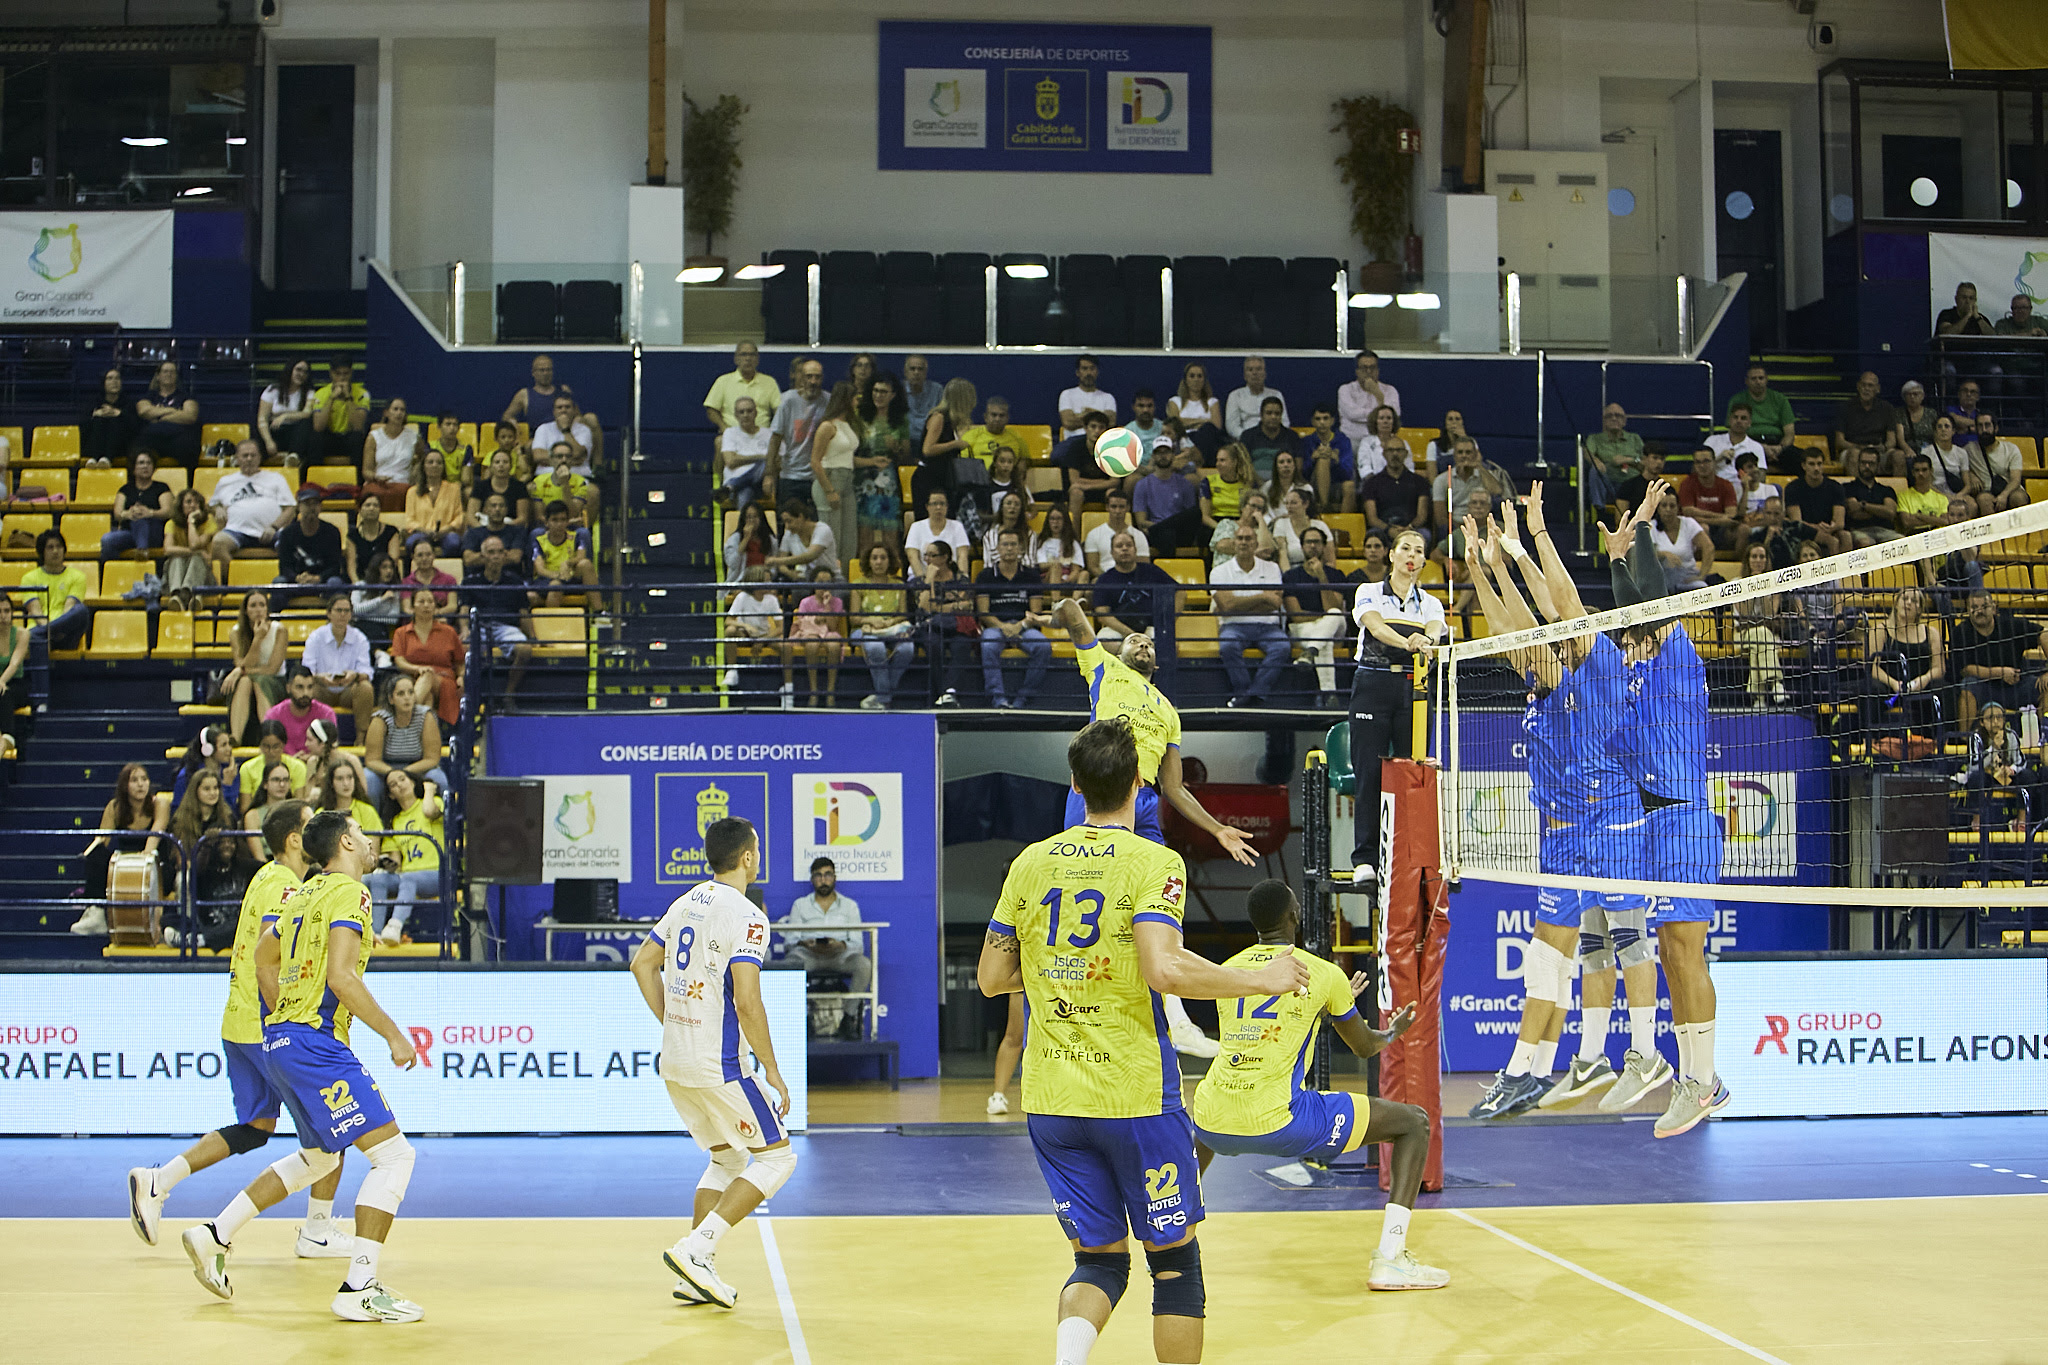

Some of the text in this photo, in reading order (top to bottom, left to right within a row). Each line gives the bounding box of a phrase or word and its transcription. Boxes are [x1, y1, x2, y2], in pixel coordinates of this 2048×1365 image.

[964, 46, 1130, 61] CONSEJERÍA DE DEPORTES
[1016, 123, 1075, 134] Cabildo de
[1011, 134, 1082, 144] Gran Canaria
[1129, 136, 1177, 146] DEPORTES
[15, 290, 93, 302] Gran Canaria
[3, 307, 106, 318] European Sport Island
[600, 742, 823, 762] CONSEJERÍA DE DEPORTES
[1227, 816, 1270, 827] GLOBUS
[542, 846, 619, 859] ran Canaria
[672, 848, 706, 861] Cabi
[1049, 842, 1115, 857] ZONCA
[590, 860, 620, 868] Deporte
[665, 862, 700, 875] Gran
[835, 862, 887, 873] EPORTES
[691, 890, 716, 906] UNAI
[1040, 887, 1105, 948] 13
[292, 914, 304, 959] 7
[677, 926, 695, 971] 8
[1054, 955, 1086, 968] Islas
[1068, 1003, 1100, 1013] Icare
[1240, 1024, 1261, 1033] Islas
[1798, 1012, 1883, 1031] GRUPO
[0, 1026, 78, 1045] RUPO
[443, 1026, 534, 1044] GRUPO
[1224, 1032, 1259, 1041] Canarias
[1042, 1048, 1111, 1063] VISTAFLOR
[1797, 1036, 1937, 1065] RAFAEL
[443, 1052, 593, 1079] RAFAEL
[330, 1101, 360, 1121] HOTELS
[330, 1113, 367, 1138] HPS
[1327, 1113, 1346, 1146] HPS
[1147, 1194, 1182, 1213] HOTELS
